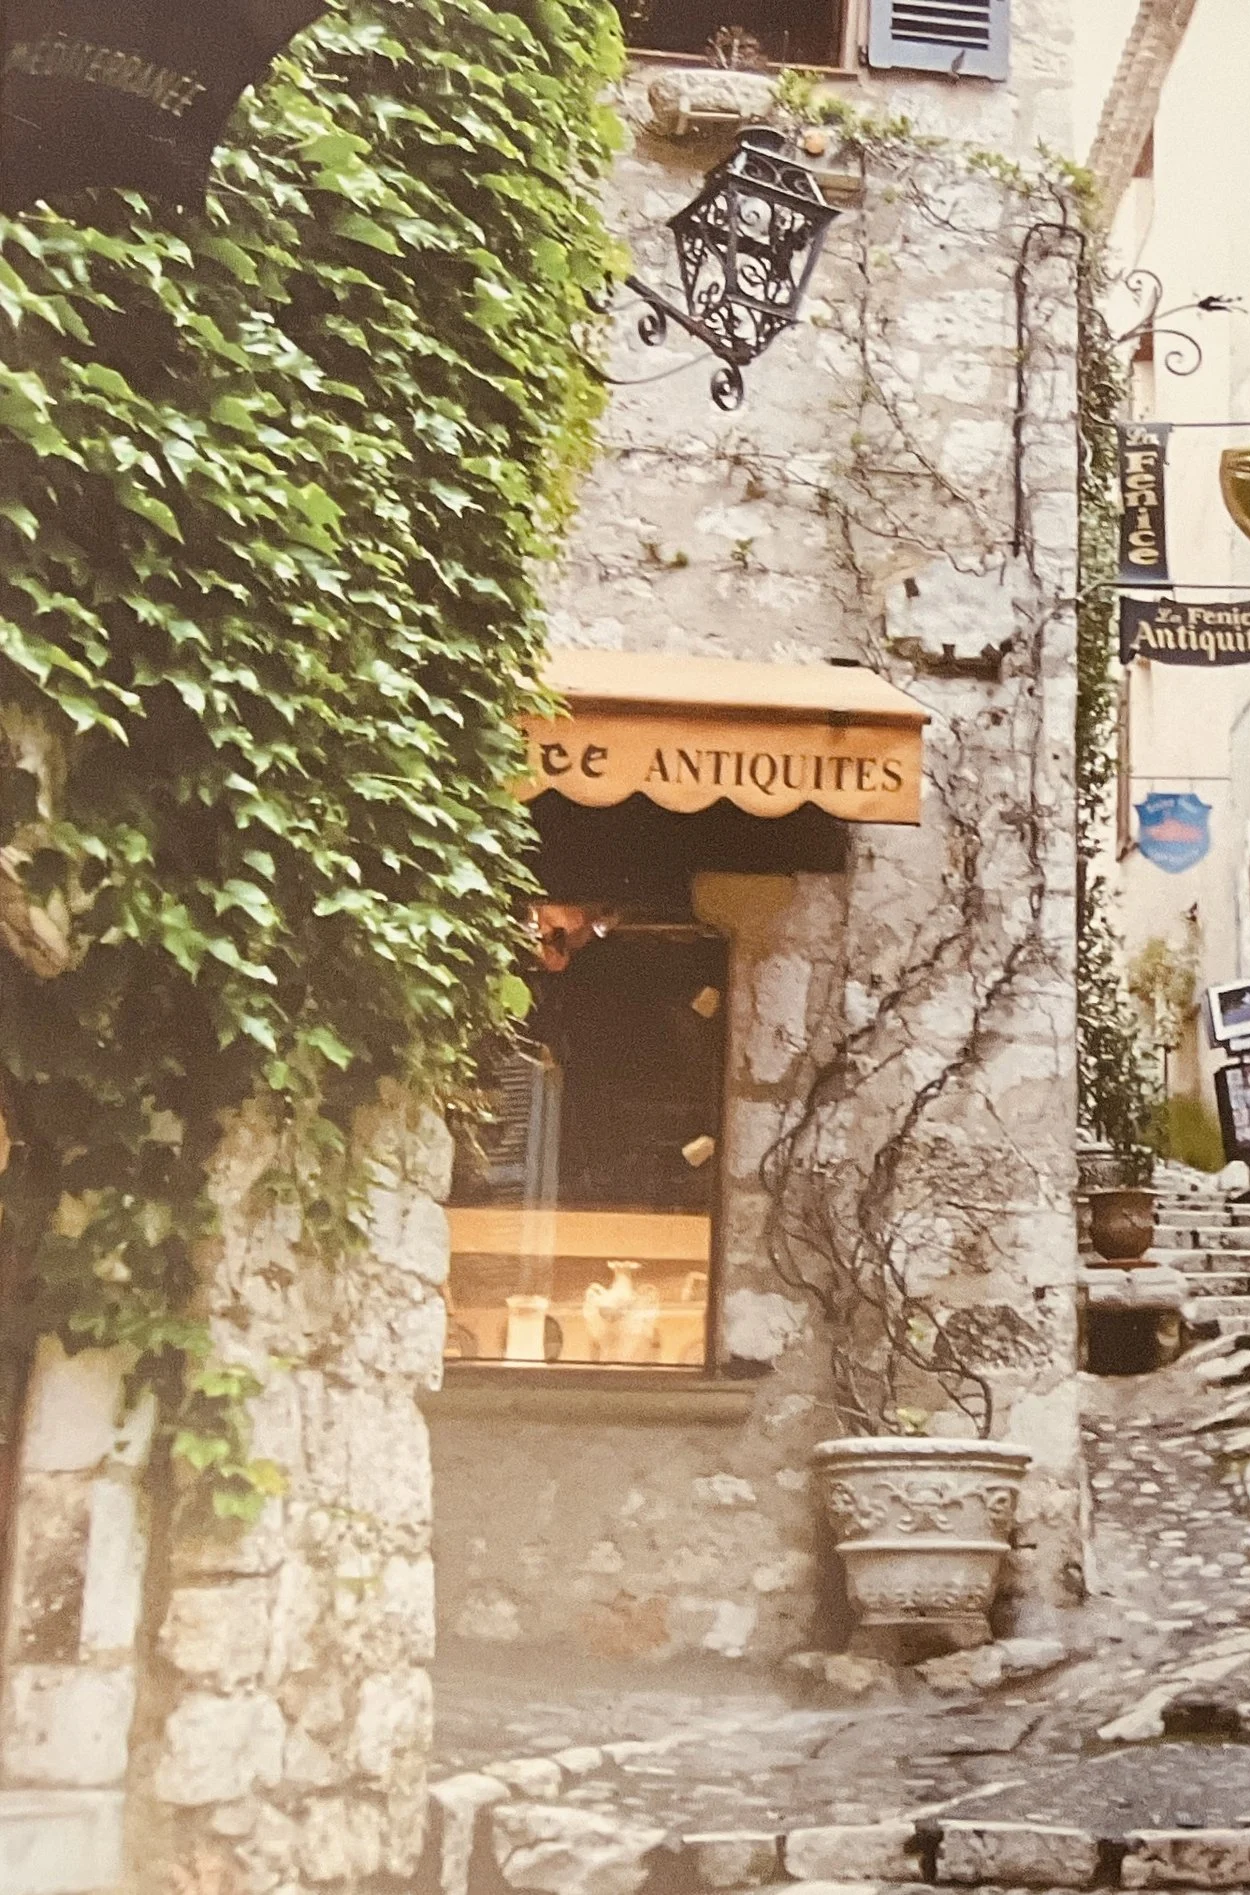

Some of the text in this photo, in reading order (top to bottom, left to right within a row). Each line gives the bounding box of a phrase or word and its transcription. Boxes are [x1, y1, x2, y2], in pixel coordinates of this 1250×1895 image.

[1125, 450, 1160, 566] Fenice
[521, 730, 902, 795] ce ANTIQUITES
